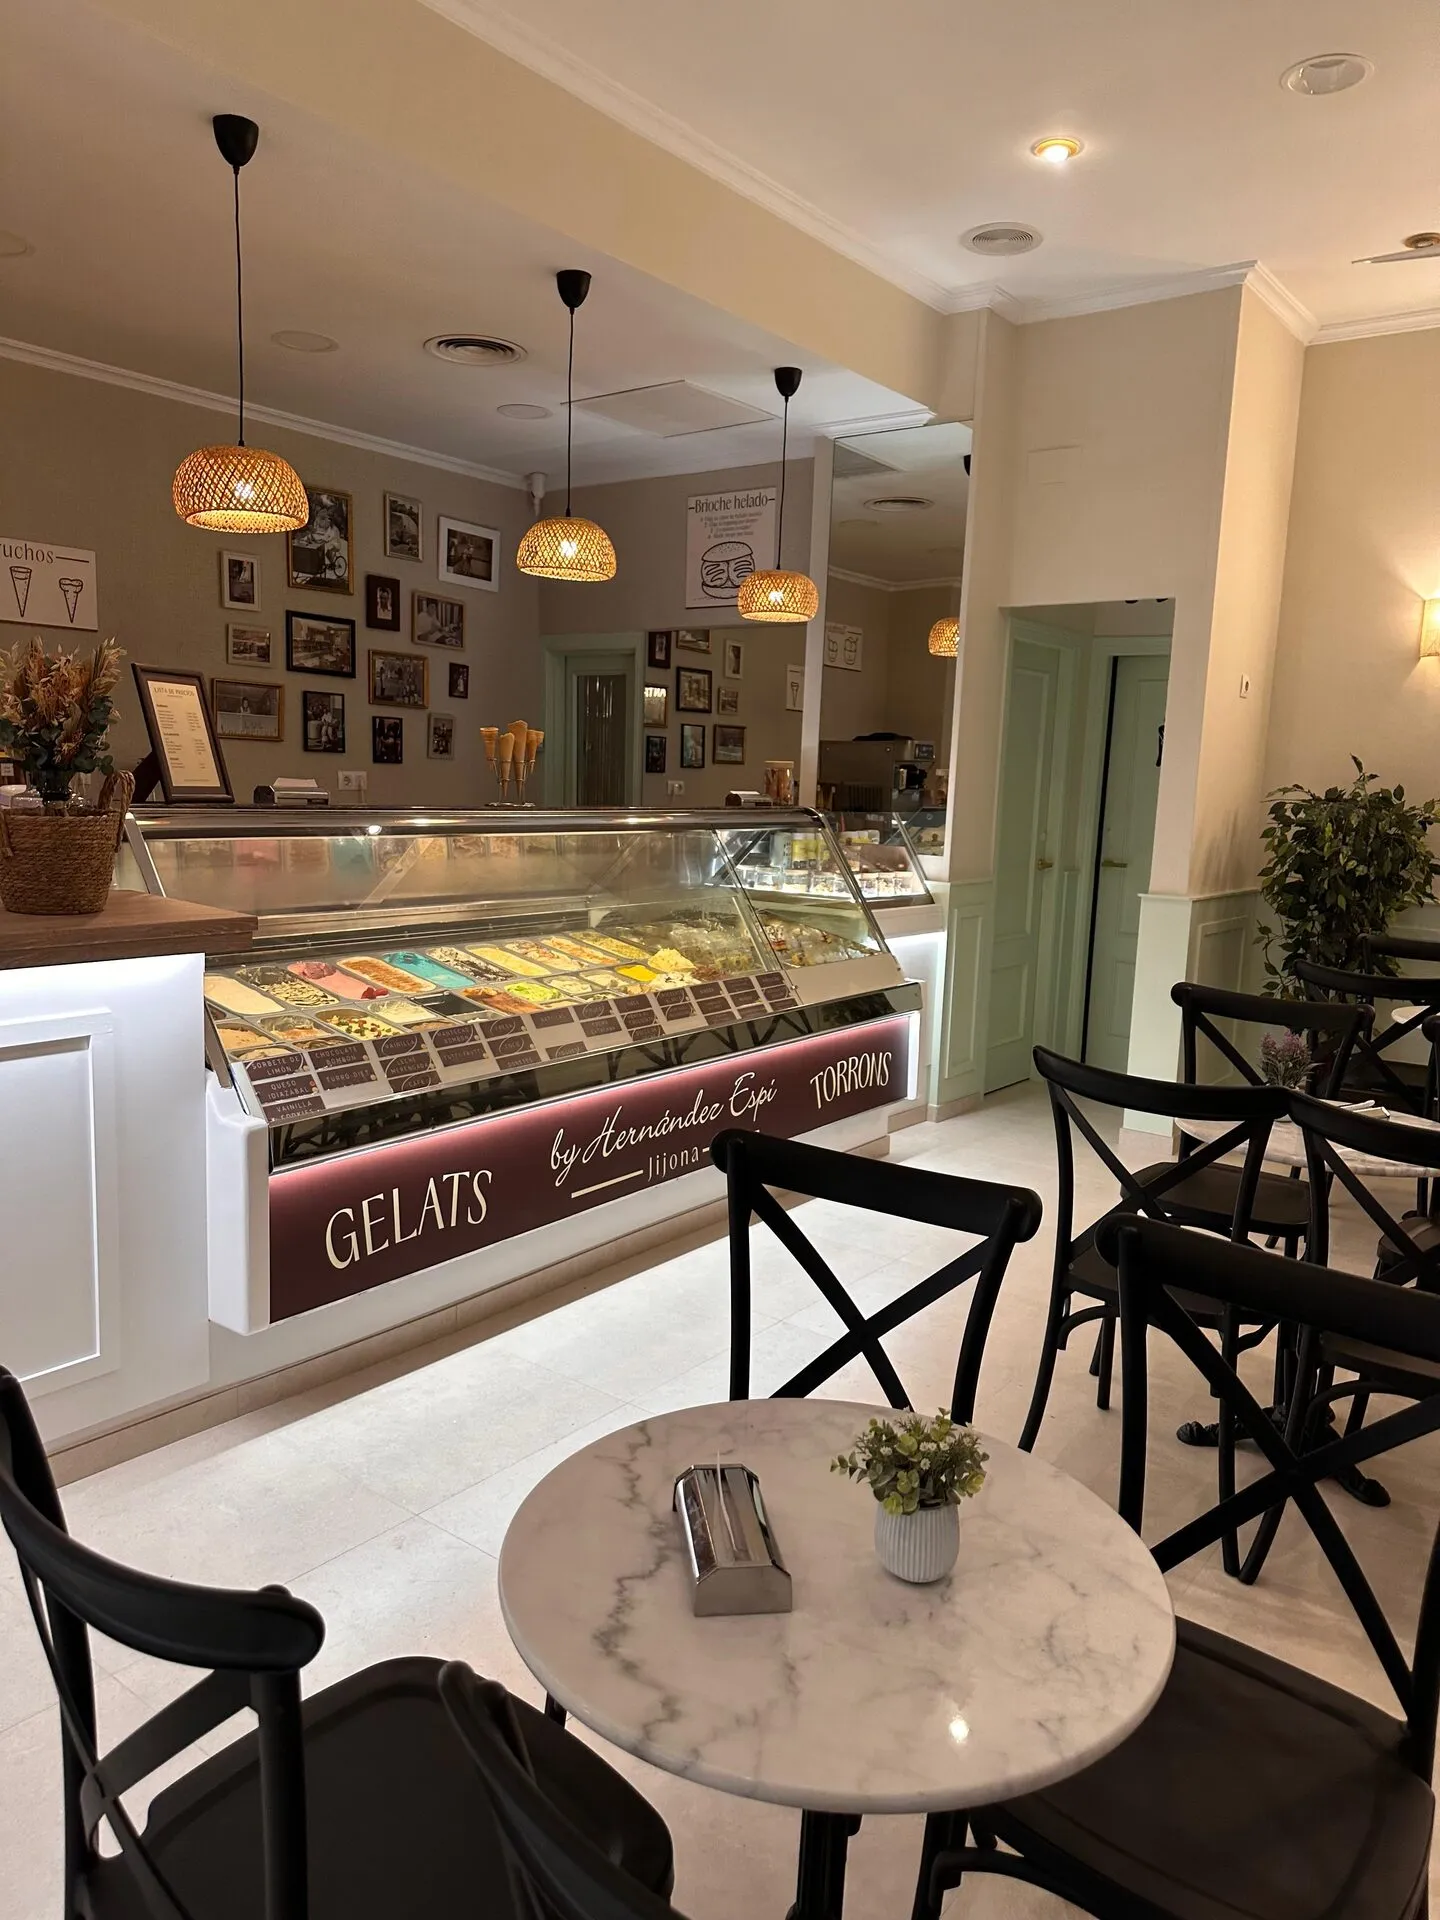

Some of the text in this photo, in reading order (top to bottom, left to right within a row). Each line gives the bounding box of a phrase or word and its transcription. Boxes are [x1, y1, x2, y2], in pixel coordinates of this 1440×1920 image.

[695, 493, 768, 513] Brioche helado
[252, 1058, 287, 1070] SORBETE
[271, 1080, 297, 1090] QUESO
[810, 1052, 892, 1109] TORRONS
[276, 1100, 312, 1113] VAINILLA
[550, 1072, 778, 1187] by Hernández Espí
[325, 1169, 493, 1270] GELATS
